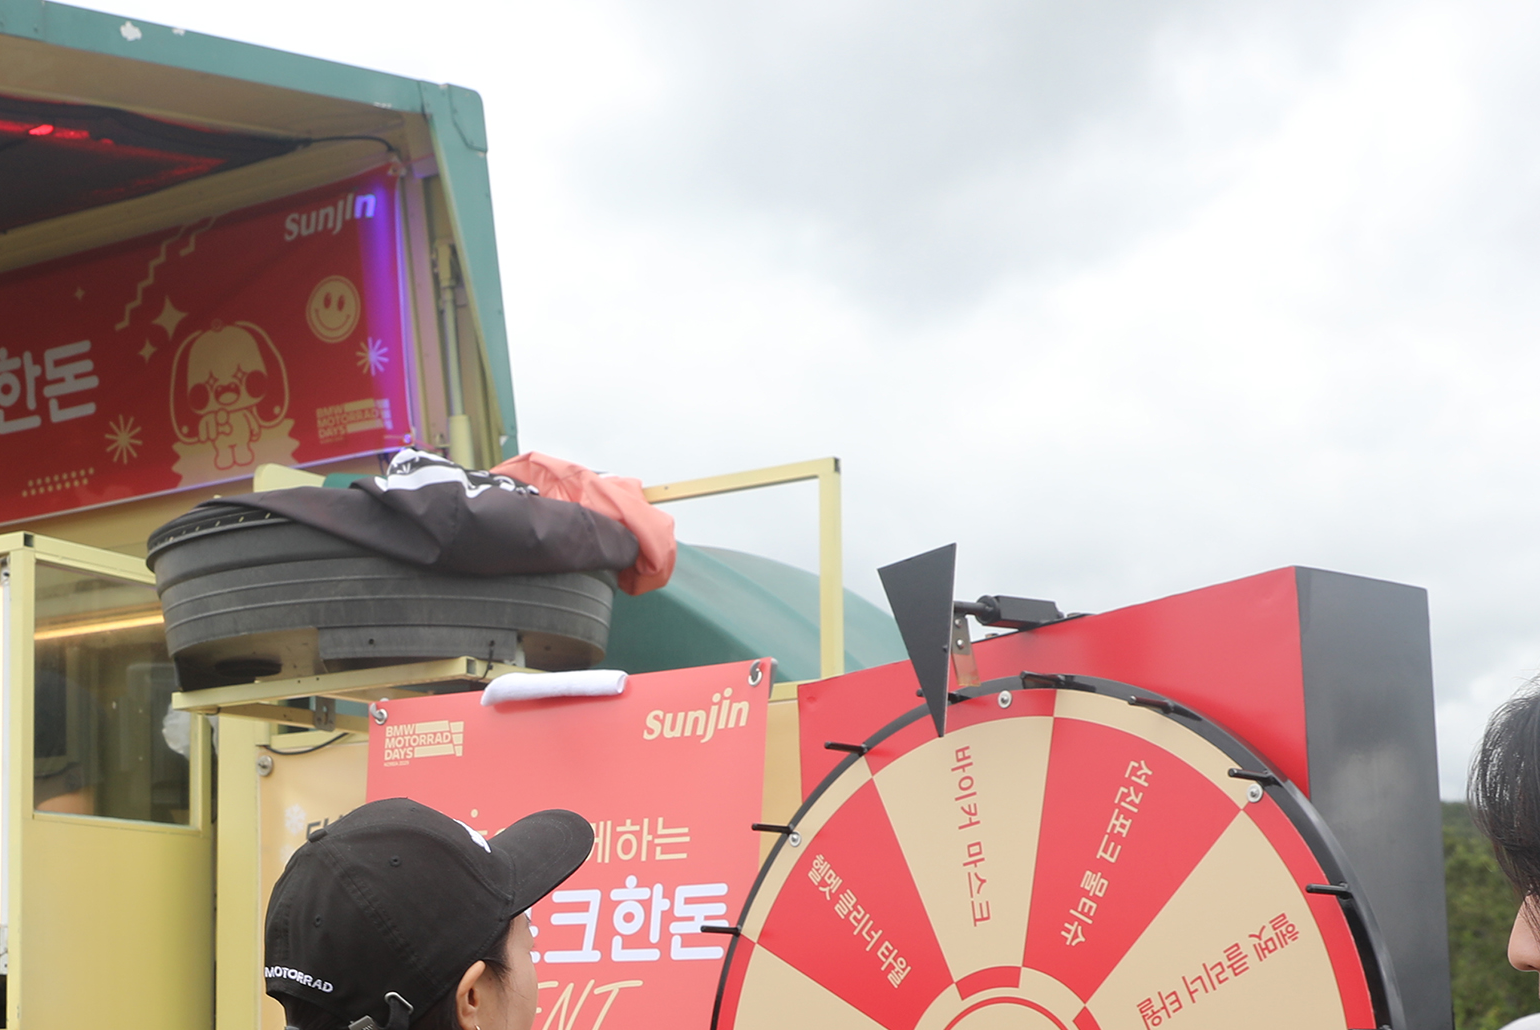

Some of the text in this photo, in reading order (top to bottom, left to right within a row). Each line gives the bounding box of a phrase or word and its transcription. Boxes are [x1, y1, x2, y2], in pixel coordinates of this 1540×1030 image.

[384, 747, 413, 761] DAYS
[385, 724, 415, 737] BMW
[385, 732, 451, 749] MOTORRAD
[951, 745, 991, 927] 바이커 마스크
[1060, 760, 1153, 946] 선진포크 물티슈
[807, 854, 911, 989] 헬멧 클리너 타월
[1248, 913, 1299, 962] 헬멧
[264, 965, 334, 993] MOTORRAD
[1182, 943, 1250, 1004] 클리너
